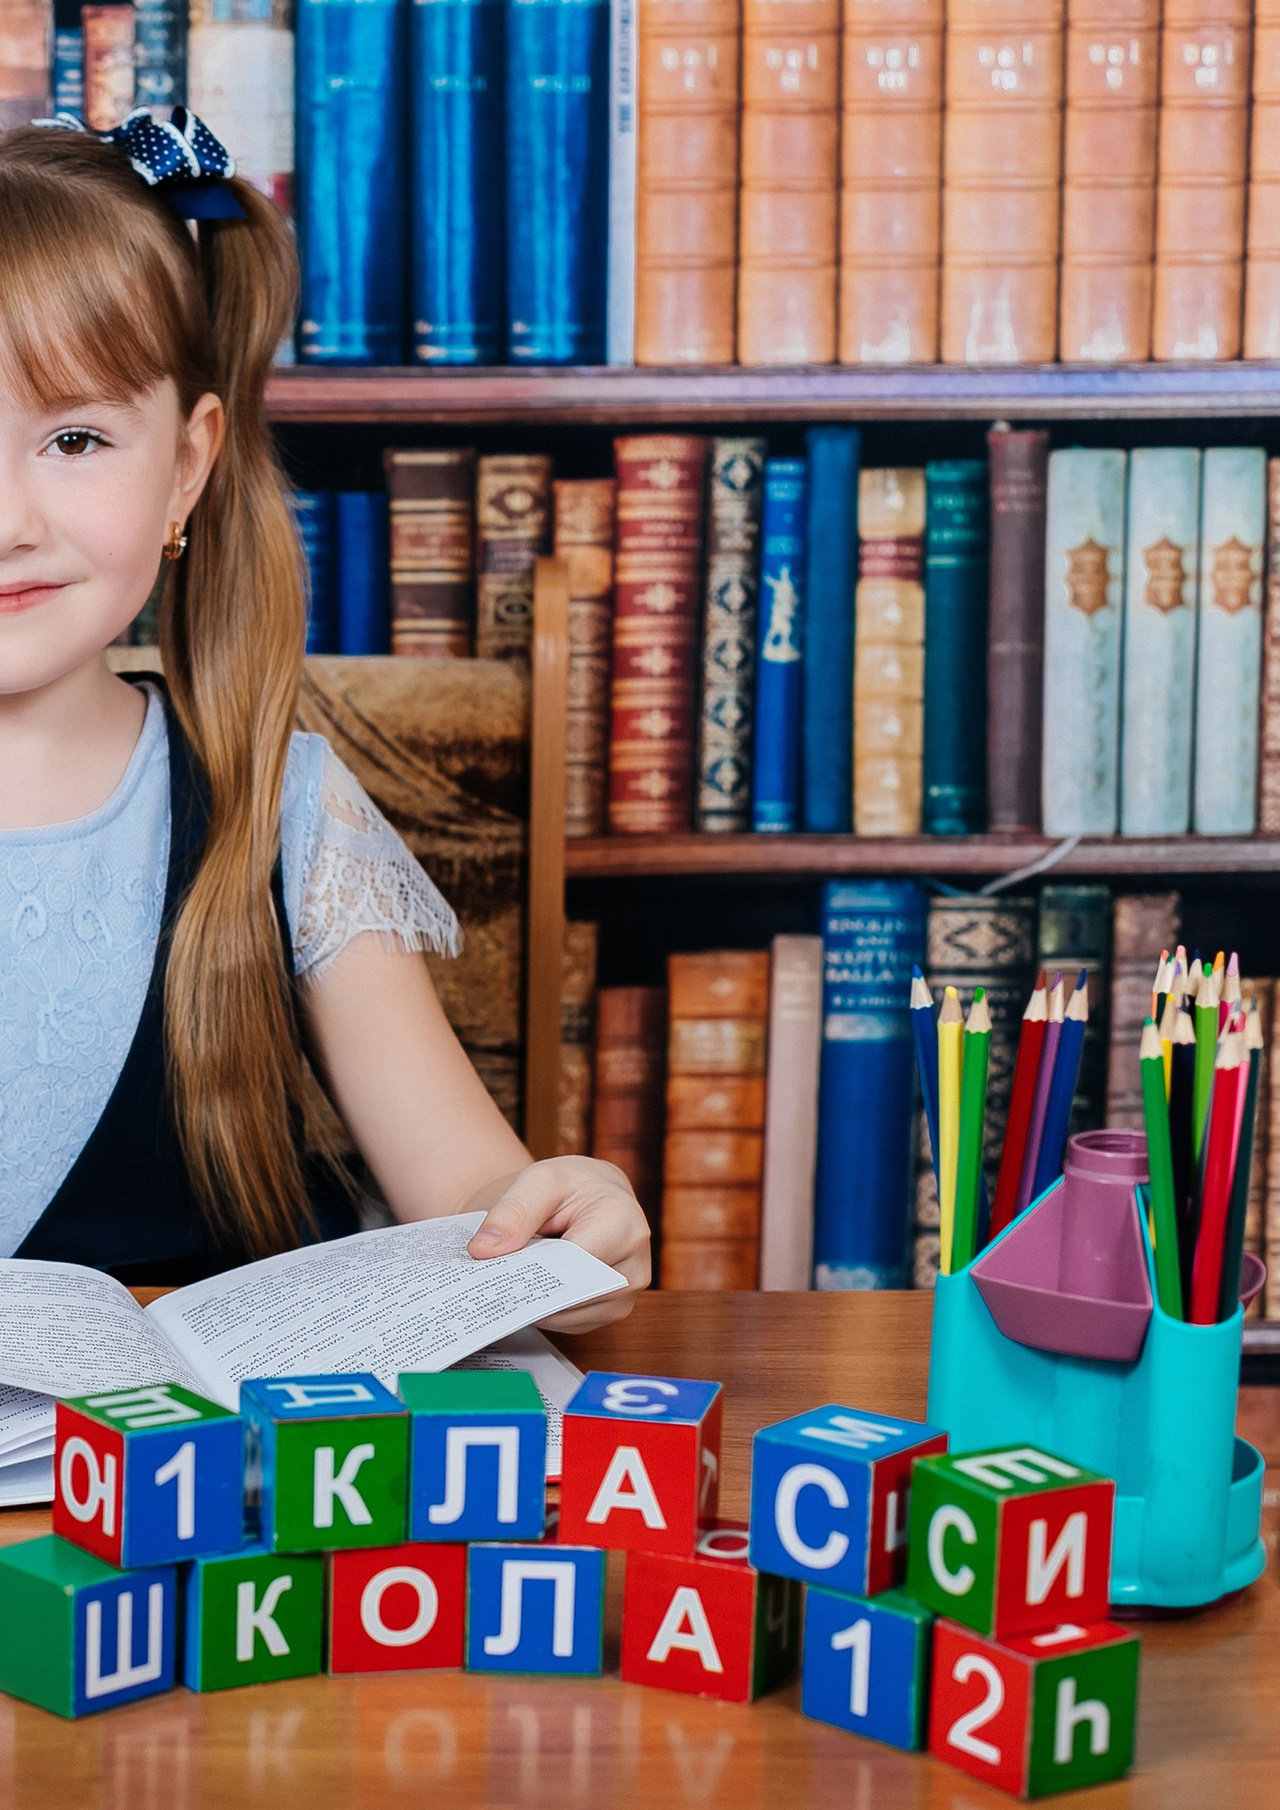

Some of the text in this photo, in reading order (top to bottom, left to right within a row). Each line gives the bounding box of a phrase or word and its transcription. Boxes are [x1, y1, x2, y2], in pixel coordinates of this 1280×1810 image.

[154, 1442, 196, 1540] 1
[830, 1618, 1005, 1766] 1 2
